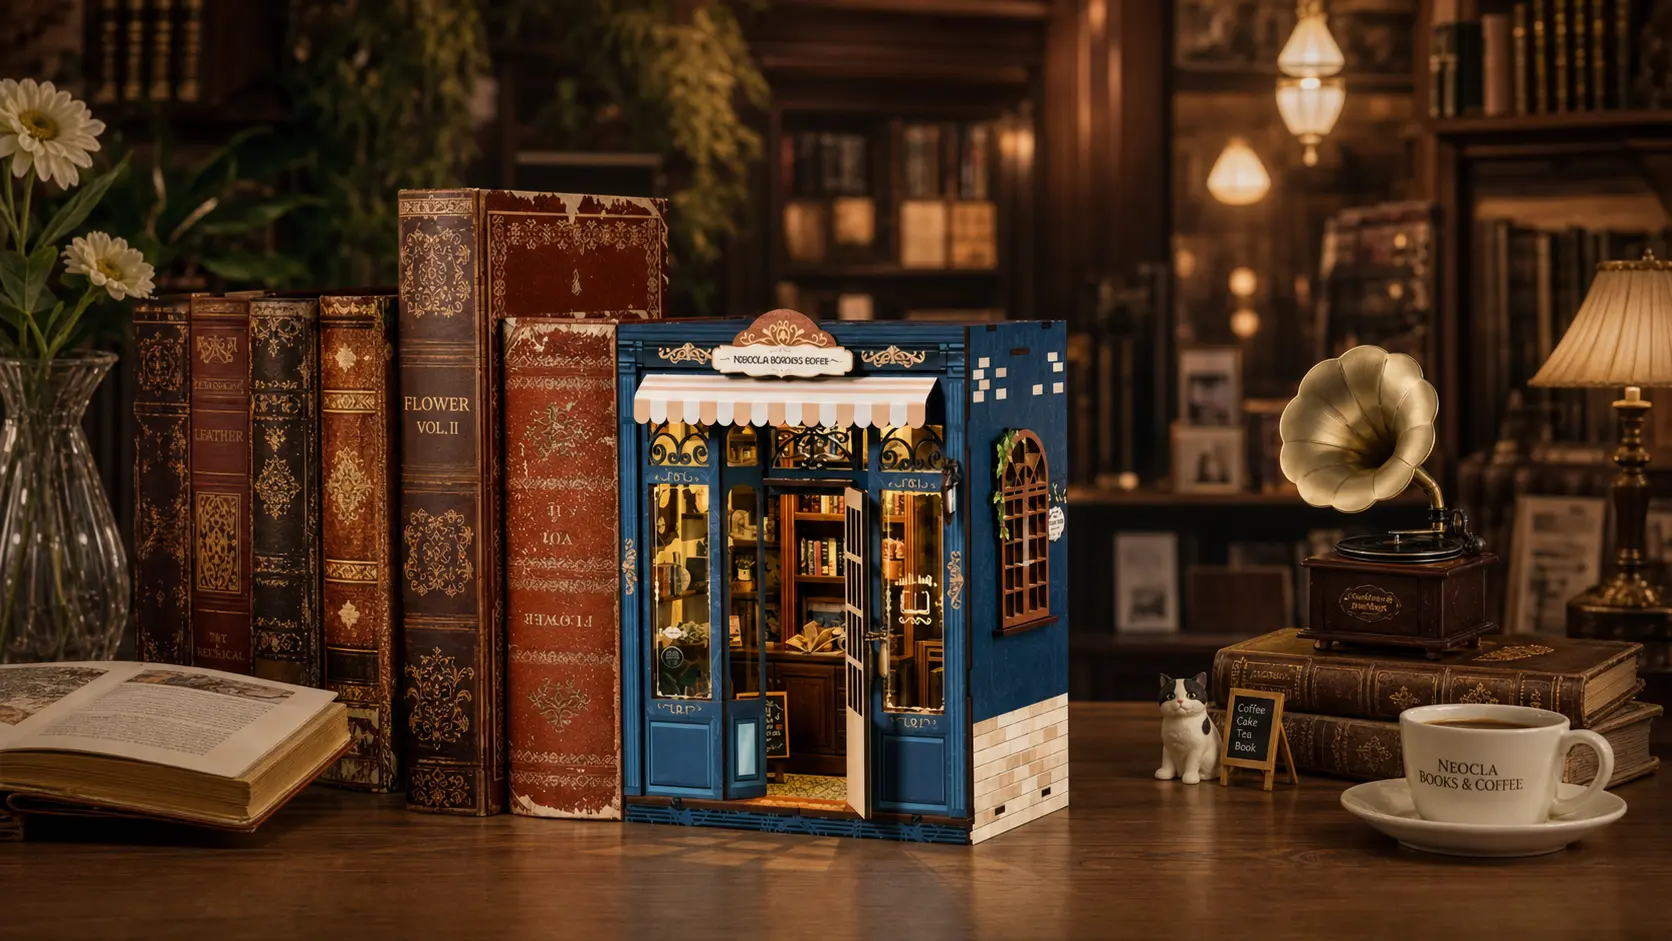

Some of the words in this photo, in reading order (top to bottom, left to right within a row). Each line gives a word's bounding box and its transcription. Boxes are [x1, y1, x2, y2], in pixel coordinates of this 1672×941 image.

[404, 396, 470, 411] FLOWER
[417, 421, 448, 434] VOL.
[449, 421, 459, 434] II
[194, 429, 244, 442] LEATHER
[1237, 703, 1266, 714] Coffee
[1236, 716, 1258, 727] Cake
[1236, 728, 1252, 739] Tea
[1235, 741, 1257, 752] Book
[1438, 758, 1498, 776] NEOCLA
[1419, 769, 1458, 789] BOOKS
[1462, 778, 1472, 791] &
[1475, 778, 1523, 791] COFFEE
